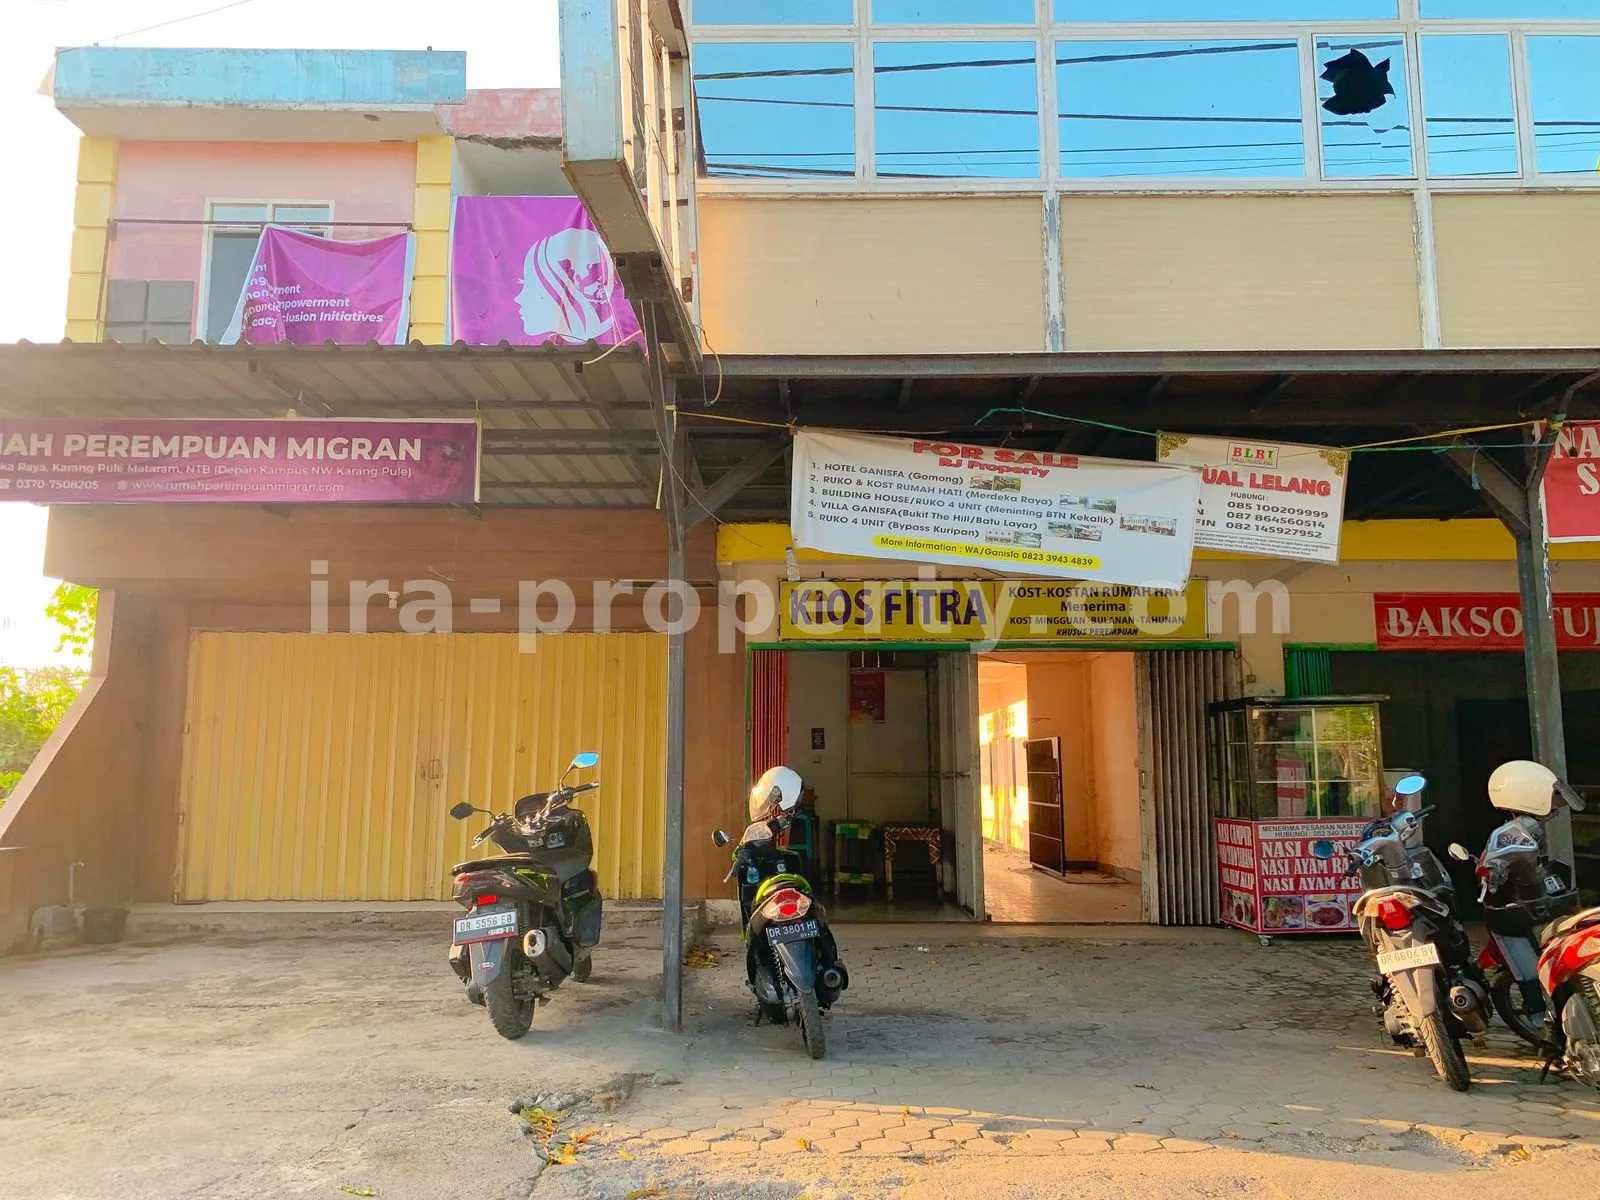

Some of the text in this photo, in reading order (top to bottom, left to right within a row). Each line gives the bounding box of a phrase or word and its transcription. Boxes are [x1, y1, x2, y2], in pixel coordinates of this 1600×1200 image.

[251, 315, 278, 329] cacy
[319, 310, 385, 323] Initiatives
[0, 433, 422, 461] AH PEREMPUAN MIGRAN
[912, 441, 1079, 469] FOR SALE
[52, 463, 94, 475] Karang
[97, 463, 124, 473] Pule
[126, 464, 183, 474] Mataram,
[186, 465, 211, 474] NTB
[214, 464, 256, 476] (Depan
[259, 466, 308, 477] Kampus
[311, 466, 333, 476] NW
[336, 467, 378, 477] Karang
[381, 466, 412, 478] Pule)
[824, 463, 857, 473] HOTEL
[859, 466, 905, 478] GANISFA
[908, 471, 964, 485] (Gomong)
[967, 459, 1050, 478] Property
[16, 479, 344, 493] 0370-7508205 www.rumahperempuanmigran.com
[809, 474, 1054, 507] 2. RUKO & KOST RUMAH HATI (Merdeka Raya)
[1202, 466, 1332, 496] UAL LELANG
[1230, 491, 1266, 501] HUBUNGI
[808, 499, 817, 508] 4.
[820, 501, 849, 511] VILLA
[931, 511, 950, 521] The
[952, 514, 1001, 527] Hill/Batu
[1003, 519, 1039, 531] Layar)
[809, 486, 818, 495] 3.
[821, 488, 872, 500] BUILDING
[874, 493, 945, 508] HOUSE/RUKO
[958, 502, 983, 512] UNIT
[985, 505, 1044, 519] (Meninting
[1046, 511, 1067, 520] BTN
[1069, 512, 1115, 526] Kekalik)
[1227, 500, 1330, 519] 085 100209999
[807, 510, 981, 538] 5. RUKO 4 UNIT (Bypass Kuripan)
[1226, 511, 1252, 520] 087
[1254, 514, 1326, 529] 864560514
[1225, 521, 1252, 531] 082
[1254, 524, 1323, 539] 145927952
[880, 537, 904, 546] More
[905, 538, 958, 552] Information
[964, 546, 1020, 560] WA/Ganisfa
[1021, 551, 1045, 562] 0823
[1046, 554, 1069, 564] 3943
[1071, 557, 1094, 567] 4839
[1008, 585, 1099, 599] KOST-KOSTAN
[1102, 585, 1150, 599] RUMAH
[790, 588, 988, 626] KIOS FITRA
[1060, 601, 1126, 613] Menerima
[1009, 616, 1033, 625] KOST
[1035, 616, 1086, 625] MINGGUAN
[1384, 606, 1523, 638] BAKSO
[1056, 628, 1139, 637] KHUSUS PEREMPUAN
[1261, 841, 1302, 858] NASI
[1261, 858, 1290, 876] NASI
[1294, 857, 1328, 875] AYAM
[1263, 877, 1294, 892] NASI
[1299, 876, 1336, 891] AYAM
[460, 921, 471, 932] DR
[475, 916, 498, 929] 5556
[768, 920, 816, 938] DR 3801 HI
[1380, 954, 1392, 965] DR
[1394, 948, 1419, 961] 6604
